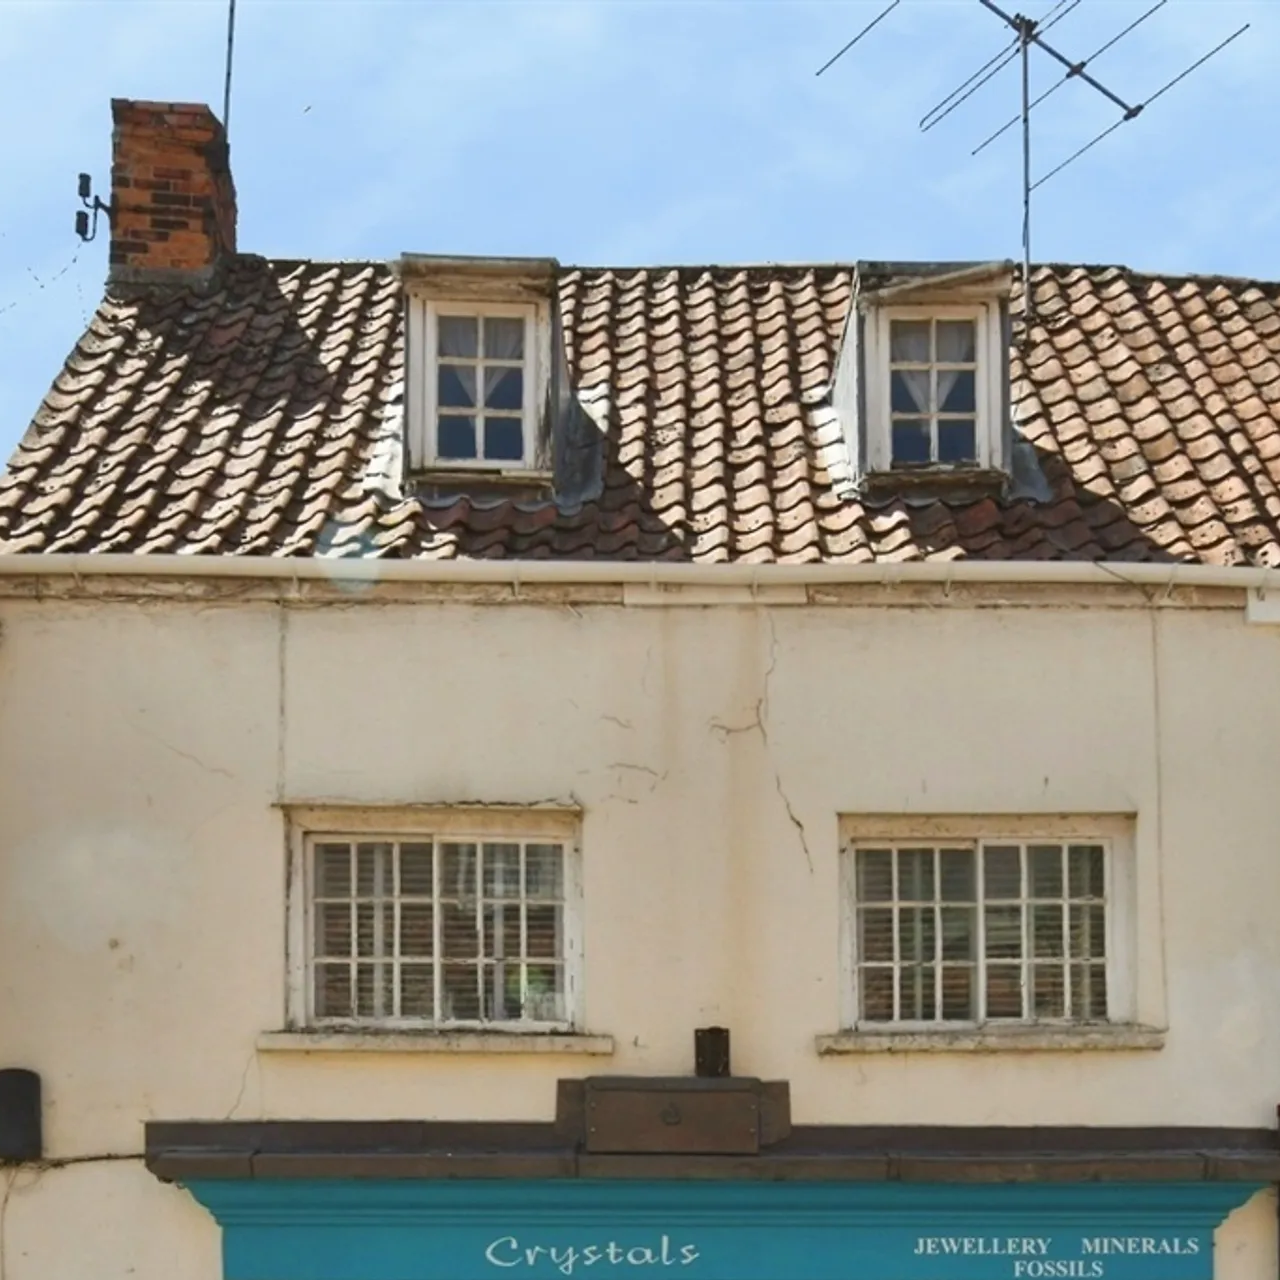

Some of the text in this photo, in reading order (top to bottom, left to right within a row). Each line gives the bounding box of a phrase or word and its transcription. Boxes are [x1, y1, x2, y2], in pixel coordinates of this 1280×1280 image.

[485, 1234, 700, 1275] Crystals
[914, 1236, 1200, 1256] JEWELLERY MINERALS
[1013, 1259, 1104, 1278] FOSSILS
